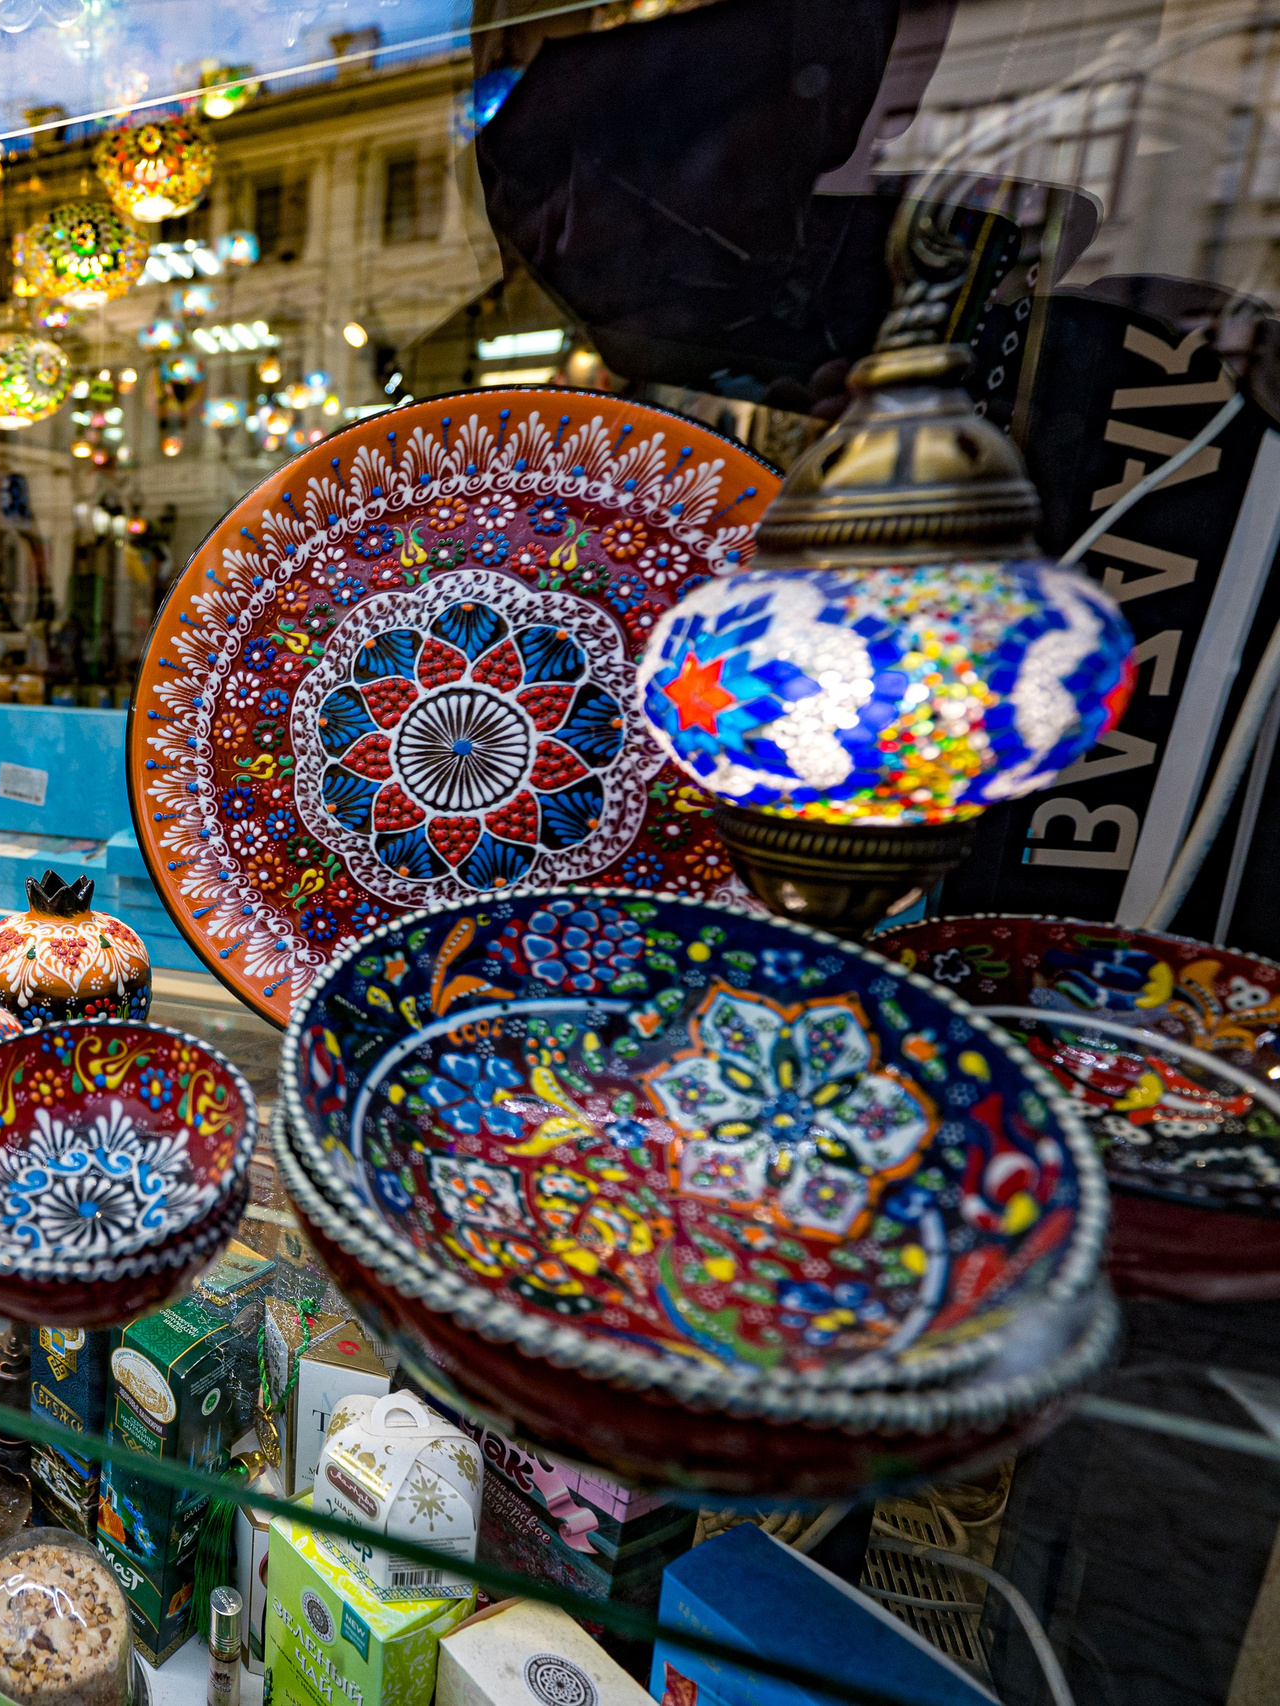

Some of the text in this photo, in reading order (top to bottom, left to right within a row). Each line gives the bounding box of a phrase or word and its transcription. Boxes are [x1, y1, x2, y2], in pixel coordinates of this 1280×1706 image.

[484, 1493, 529, 1537] изделие
[345, 1613, 366, 1638] NEW
[294, 1646, 333, 1704] ЧАЙ
